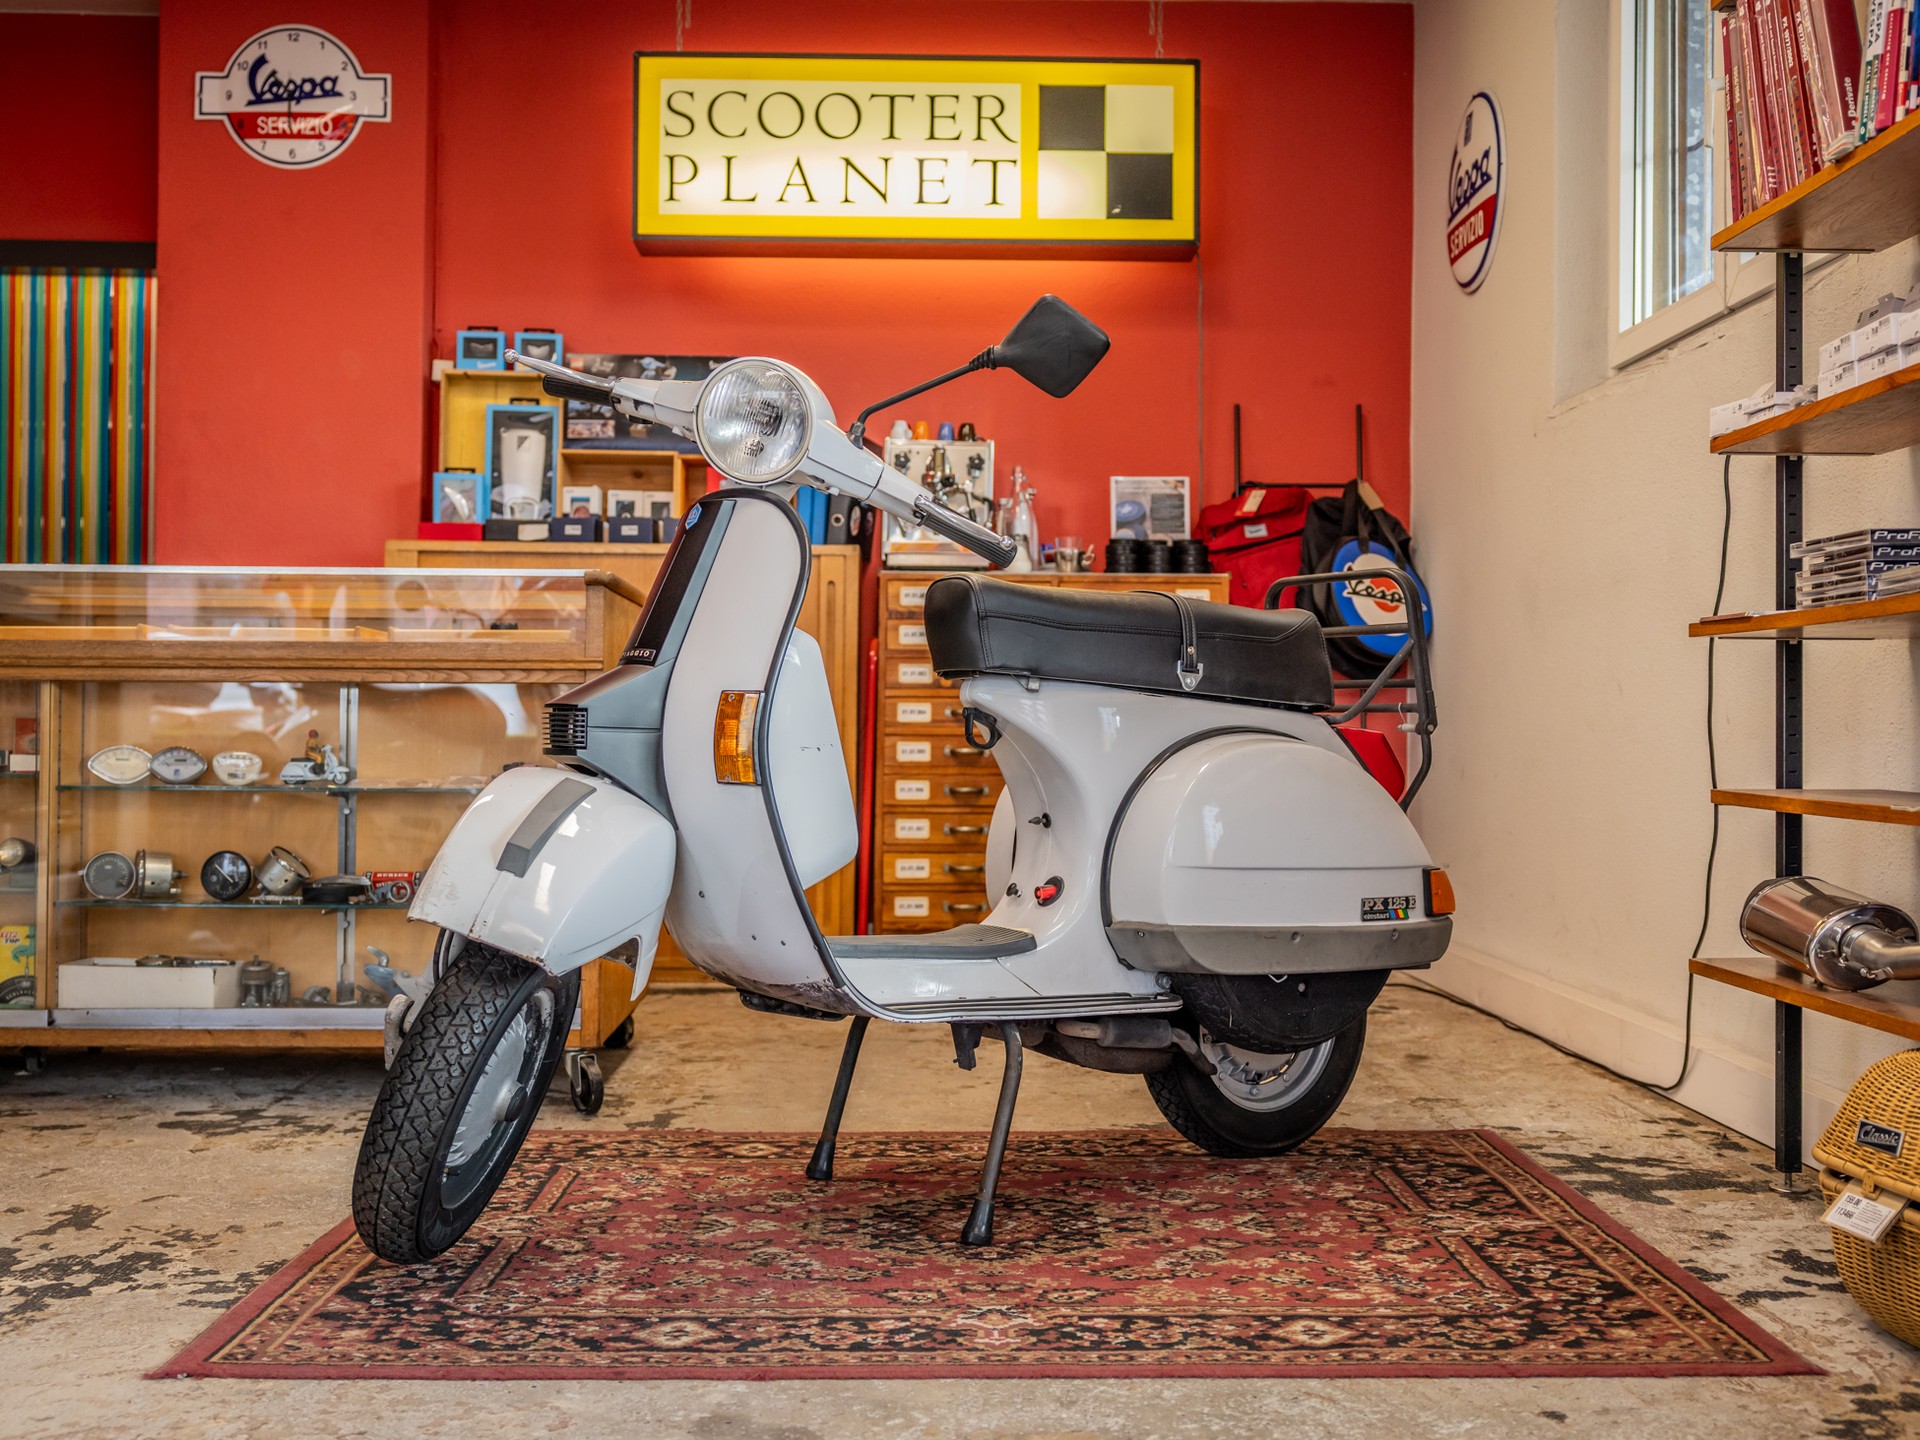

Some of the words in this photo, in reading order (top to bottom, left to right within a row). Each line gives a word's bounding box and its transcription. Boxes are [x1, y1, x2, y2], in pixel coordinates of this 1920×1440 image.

[1729, 19, 1736, 30] 2
[288, 32, 300, 42] 12
[258, 41, 268, 50] 11
[320, 41, 325, 50] 1
[237, 61, 248, 71] 10
[341, 61, 348, 71] 2
[244, 53, 343, 107] Vespa
[225, 90, 232, 101] 9
[349, 91, 357, 101] 3
[1844, 77, 1857, 117] Derivate
[664, 90, 1019, 143] SCOOTER
[256, 116, 334, 136] SERVIZIO
[261, 141, 267, 151] 7
[318, 141, 325, 152] 5
[288, 148, 296, 159] 6
[664, 154, 1018, 206] PLANET
[1448, 144, 1493, 226] Vespa
[1450, 209, 1484, 258] SERVIZIO
[1873, 530, 1920, 540] ProF
[1346, 565, 1405, 605] Vesp
[1363, 898, 1385, 910] PX
[1388, 897, 1407, 909] 125
[1408, 896, 1417, 908] E
[1859, 1124, 1899, 1146] Classic
